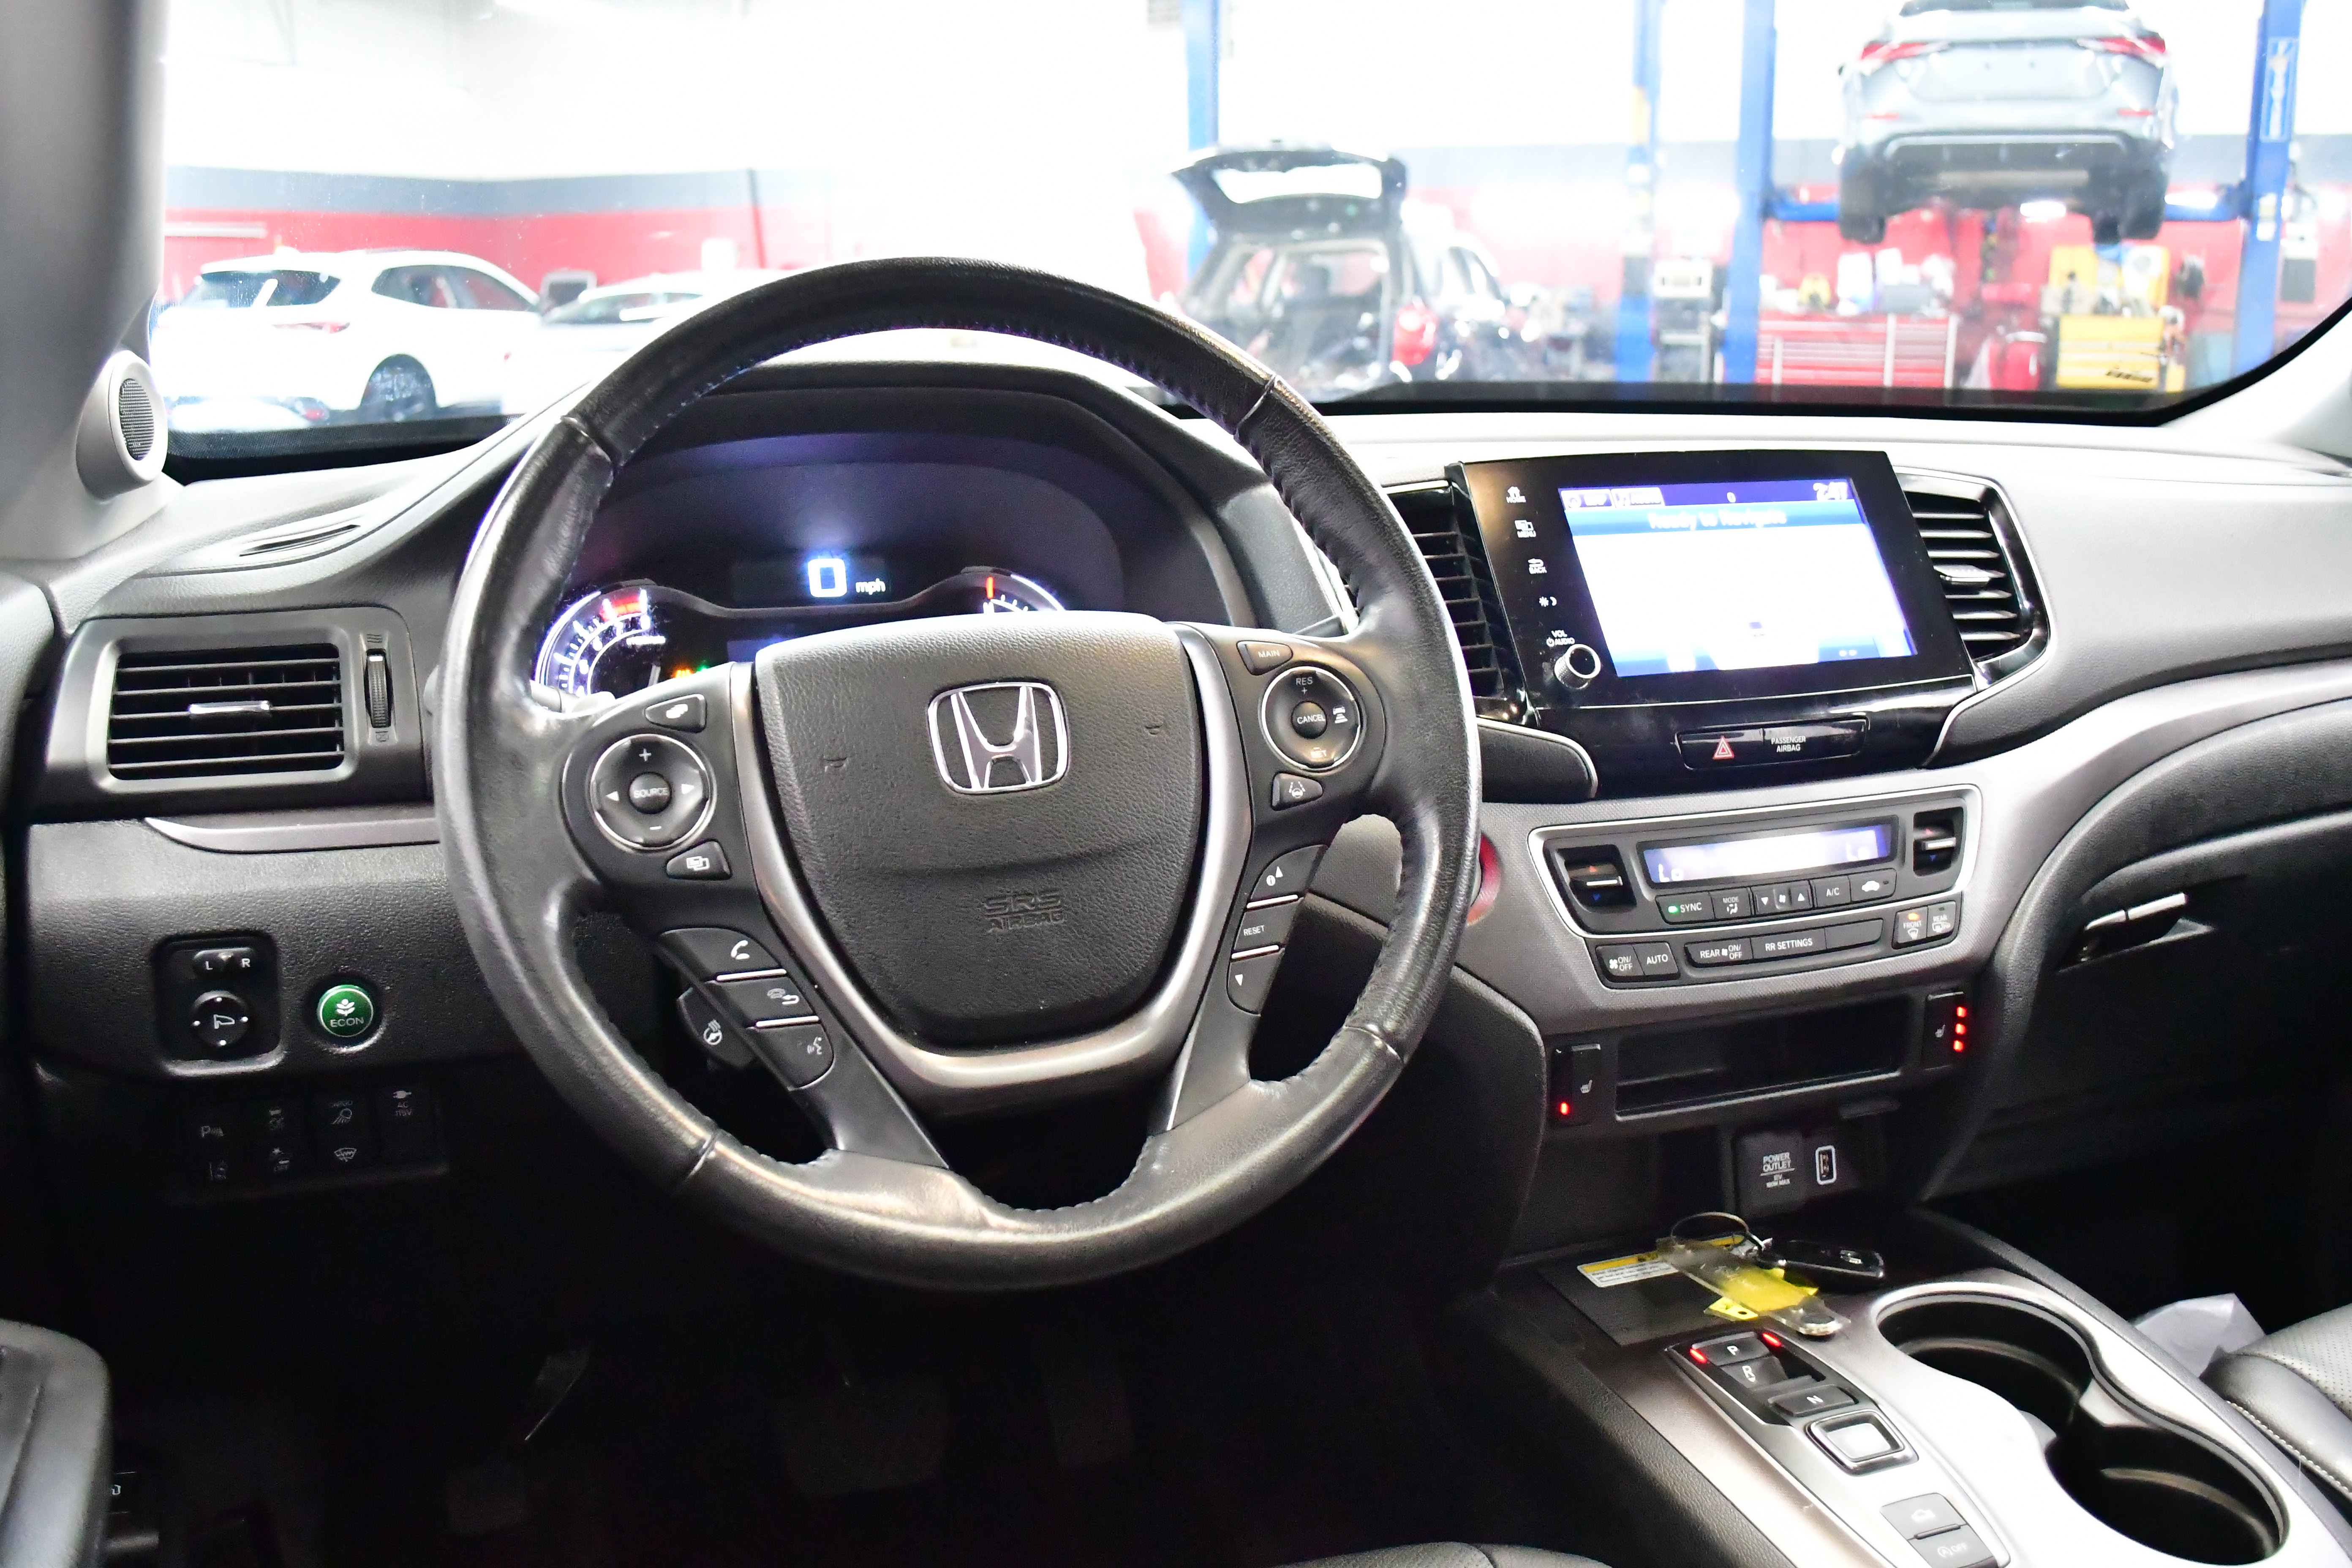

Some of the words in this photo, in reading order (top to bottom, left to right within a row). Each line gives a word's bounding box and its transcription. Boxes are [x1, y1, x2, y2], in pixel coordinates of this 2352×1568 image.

[808, 558, 847, 597] 0
[855, 578, 886, 595] mph
[1551, 630, 1568, 638] VOL
[1555, 637, 1575, 645] AUDIO
[1296, 677, 1313, 685] RES
[1297, 714, 1326, 724] CANCEL
[1771, 736, 1806, 745] PASSENGER
[1776, 744, 1801, 752] AIRBAG
[634, 787, 668, 798] SOURCE
[1826, 887, 1840, 897] A/C
[1680, 902, 1702, 912] SYNC
[1903, 920, 1921, 929] FRONT
[1243, 925, 1265, 936] RESET
[1728, 944, 1741, 952] ON/
[1765, 942, 1776, 951] RR
[1777, 938, 1813, 950] SETTINGS
[1700, 949, 1720, 958] REAR
[1729, 951, 1742, 960] OFF
[242, 958, 250, 967] R
[1647, 954, 1668, 964] AUTO
[205, 961, 213, 970] L
[1619, 962, 1633, 971] OFF
[330, 1017, 364, 1028] ECON
[1763, 1152, 1790, 1165] POWER
[1763, 1160, 1791, 1172] OUTLET
[1727, 1345, 1739, 1356] P
[1742, 1365, 1755, 1379] R
[1806, 1395, 1824, 1404] N
